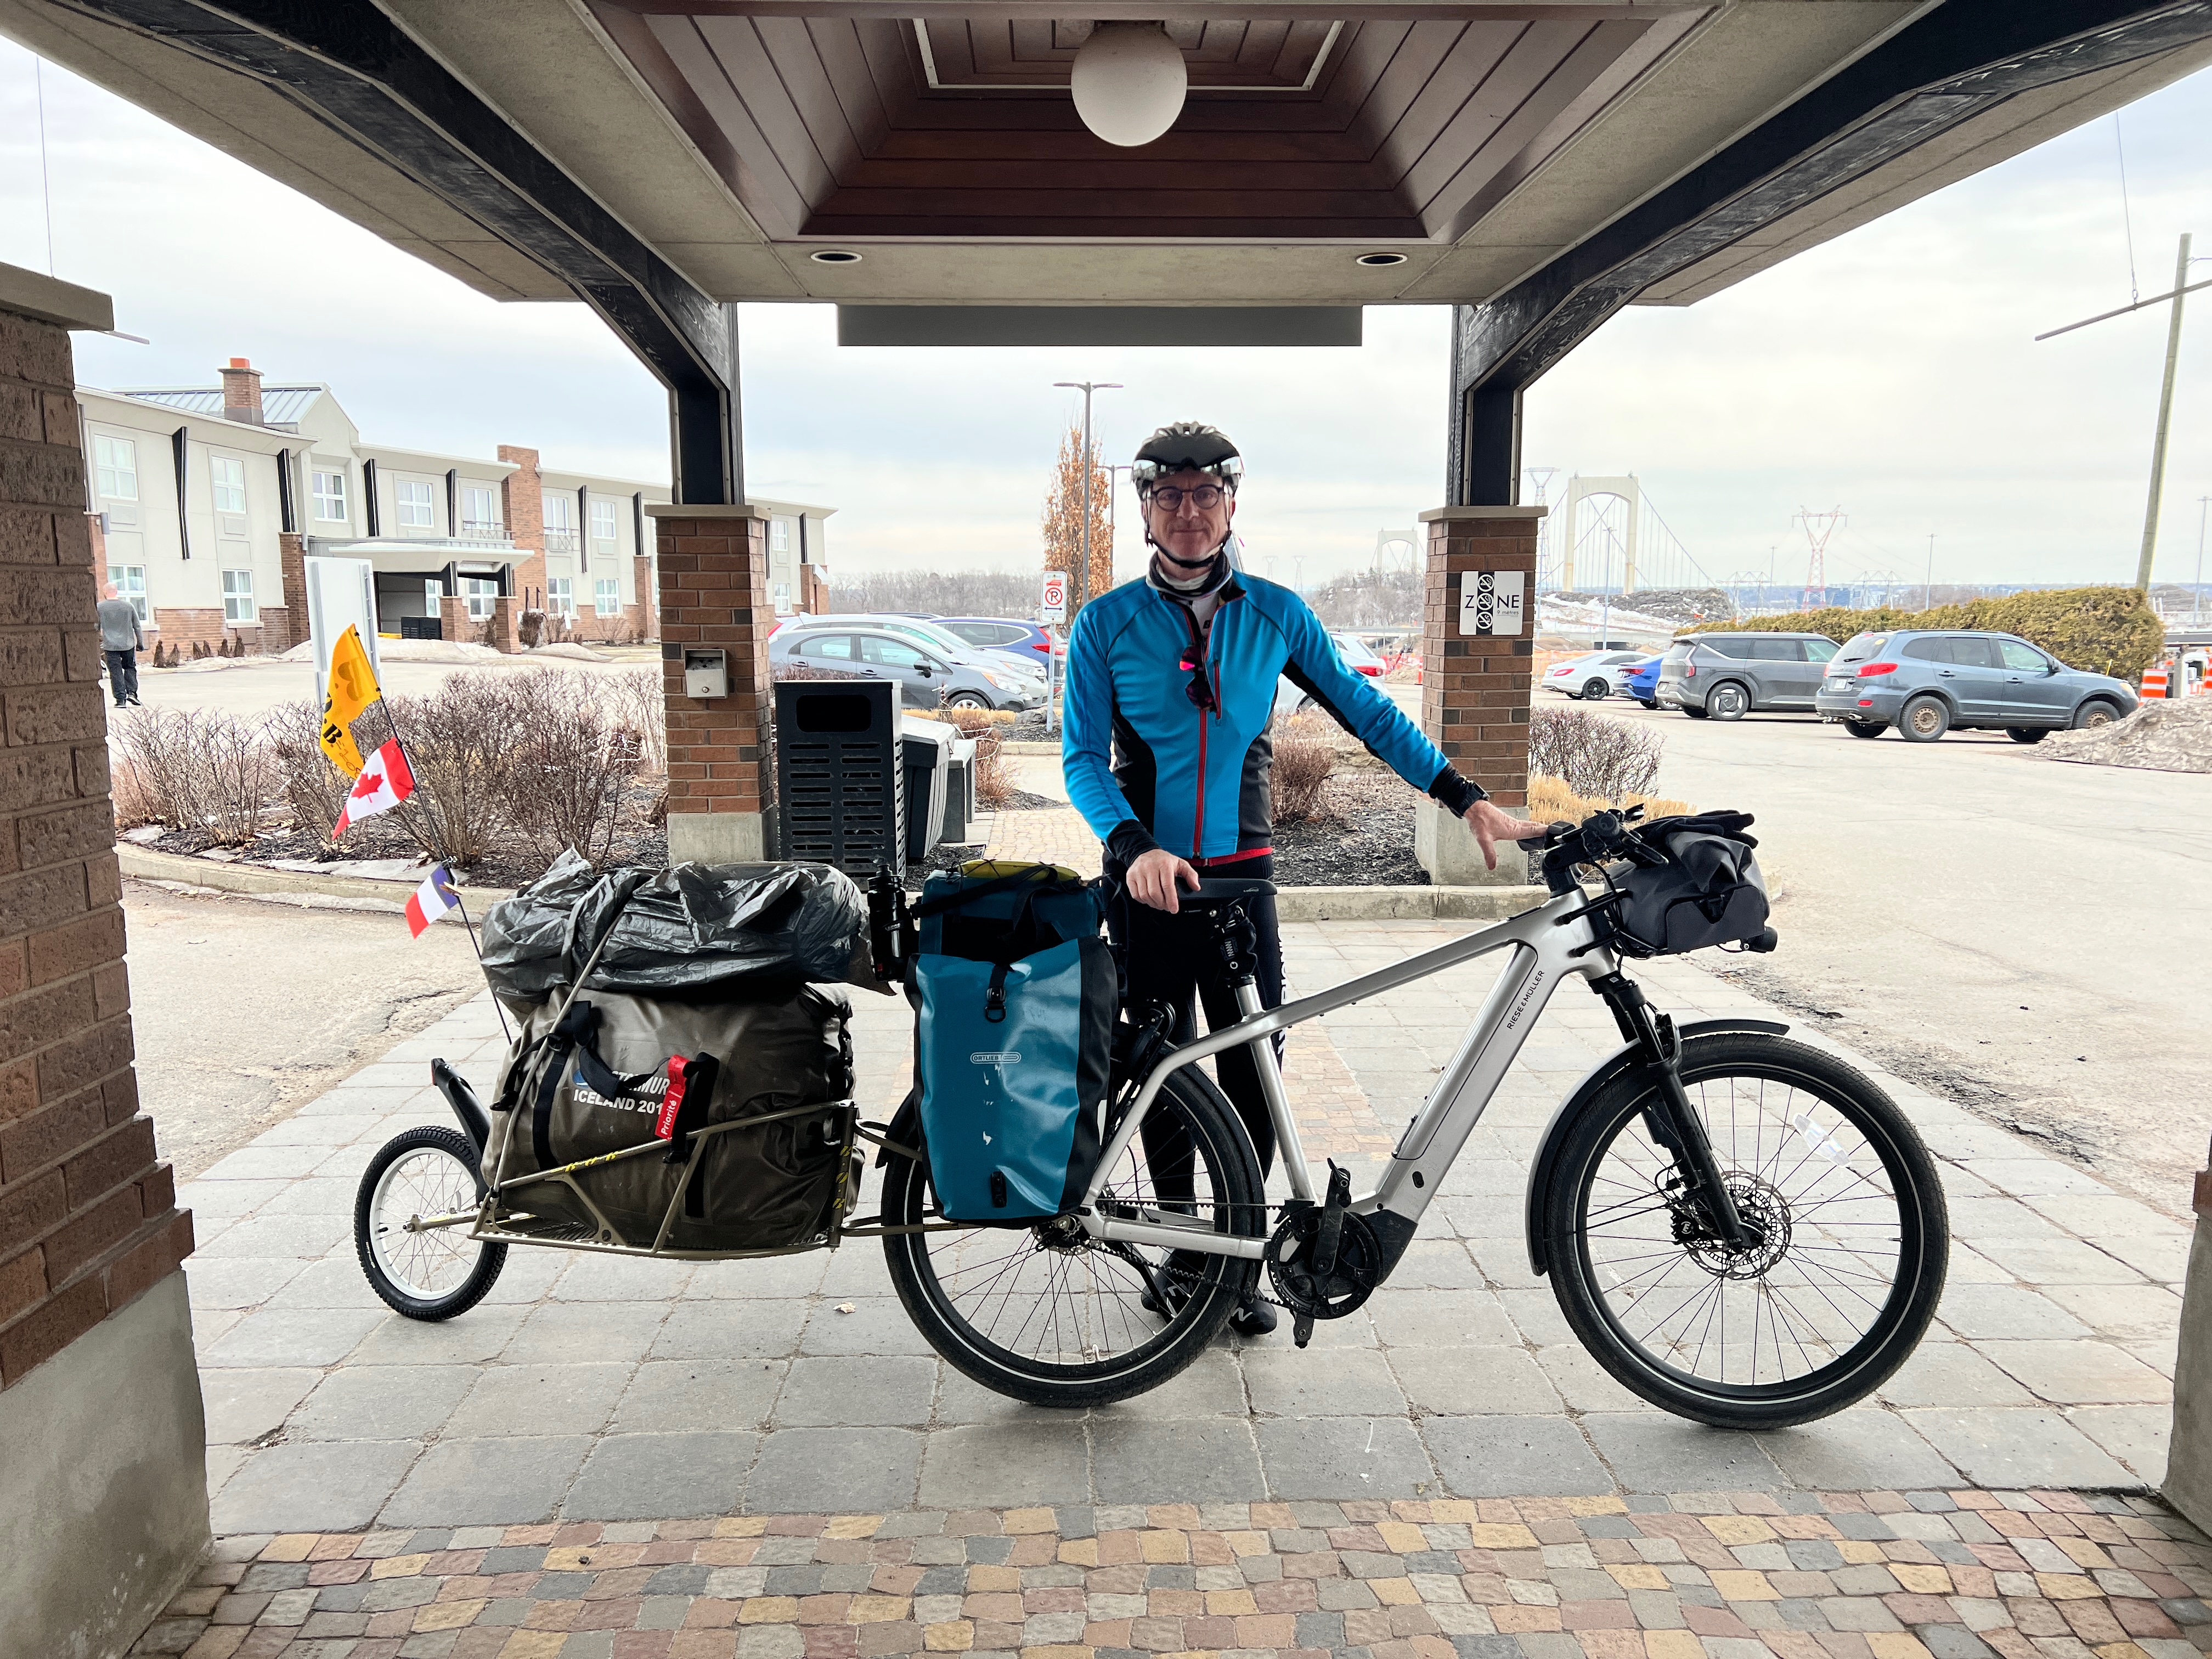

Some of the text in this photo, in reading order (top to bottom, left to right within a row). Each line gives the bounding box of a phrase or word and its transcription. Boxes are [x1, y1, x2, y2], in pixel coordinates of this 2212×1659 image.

[1506, 1006, 1524, 1030] RIESE
[1523, 970, 1545, 1002] MÜLLER
[637, 1100, 663, 1115] 201
